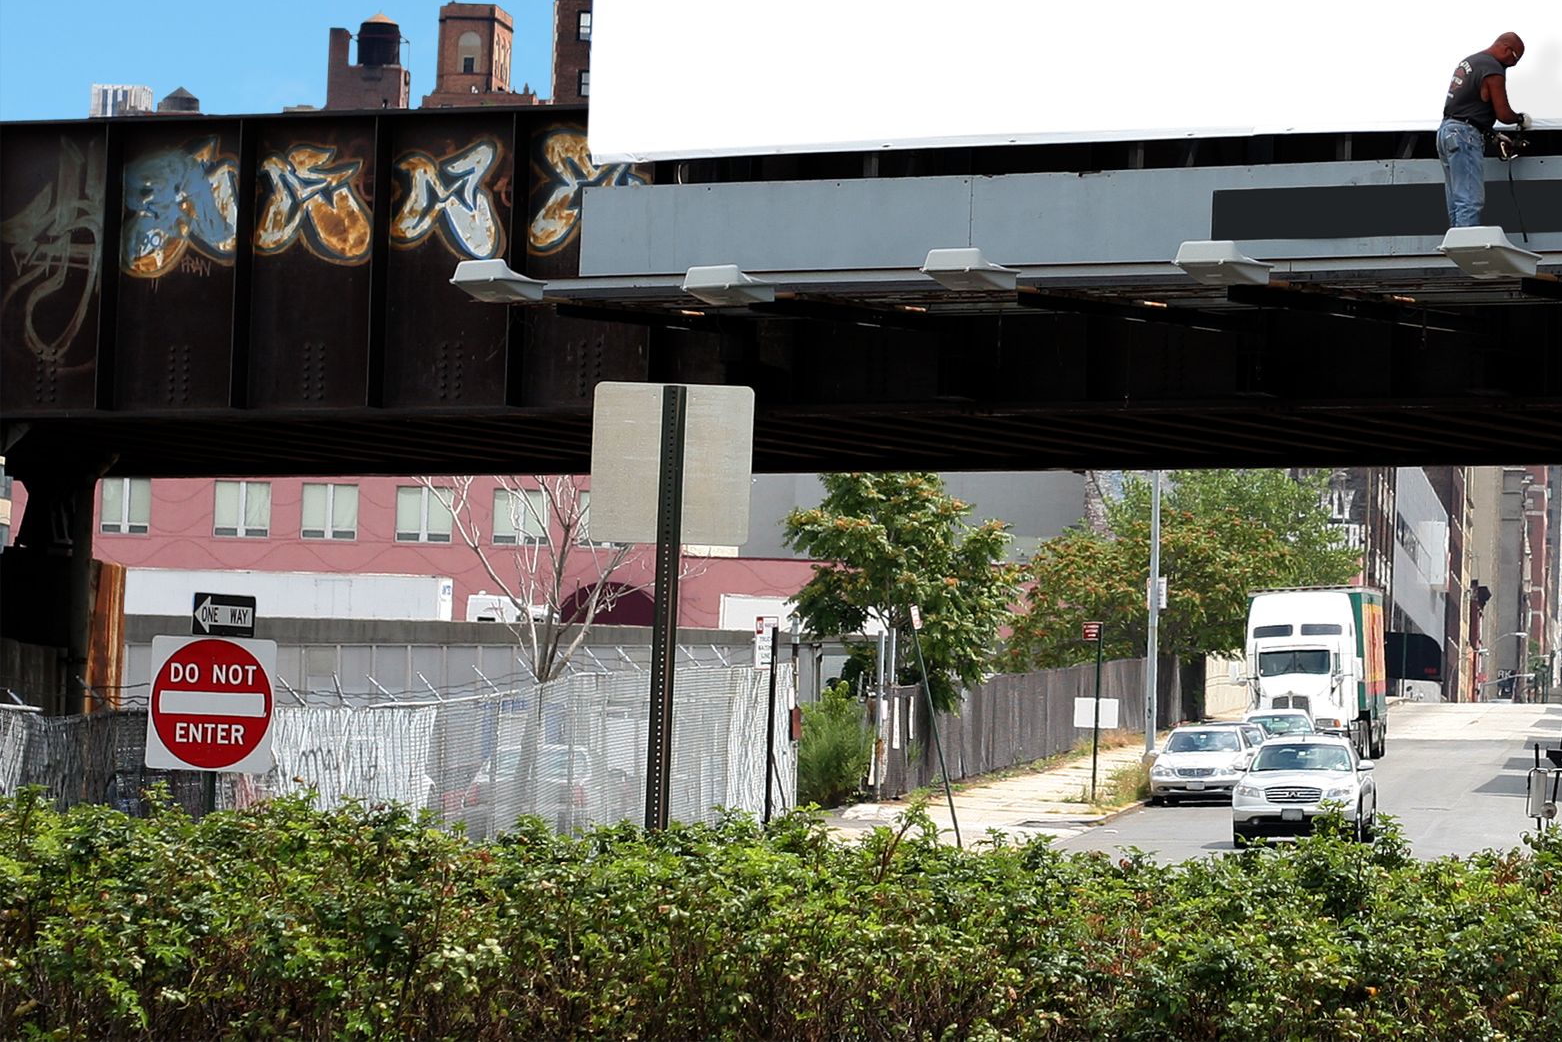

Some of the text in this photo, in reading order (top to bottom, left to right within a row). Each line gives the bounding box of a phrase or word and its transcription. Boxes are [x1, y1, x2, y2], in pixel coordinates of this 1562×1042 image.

[202, 607, 249, 624] ONE WAY
[170, 662, 257, 686] DO NOT
[175, 722, 245, 745] ENTER
